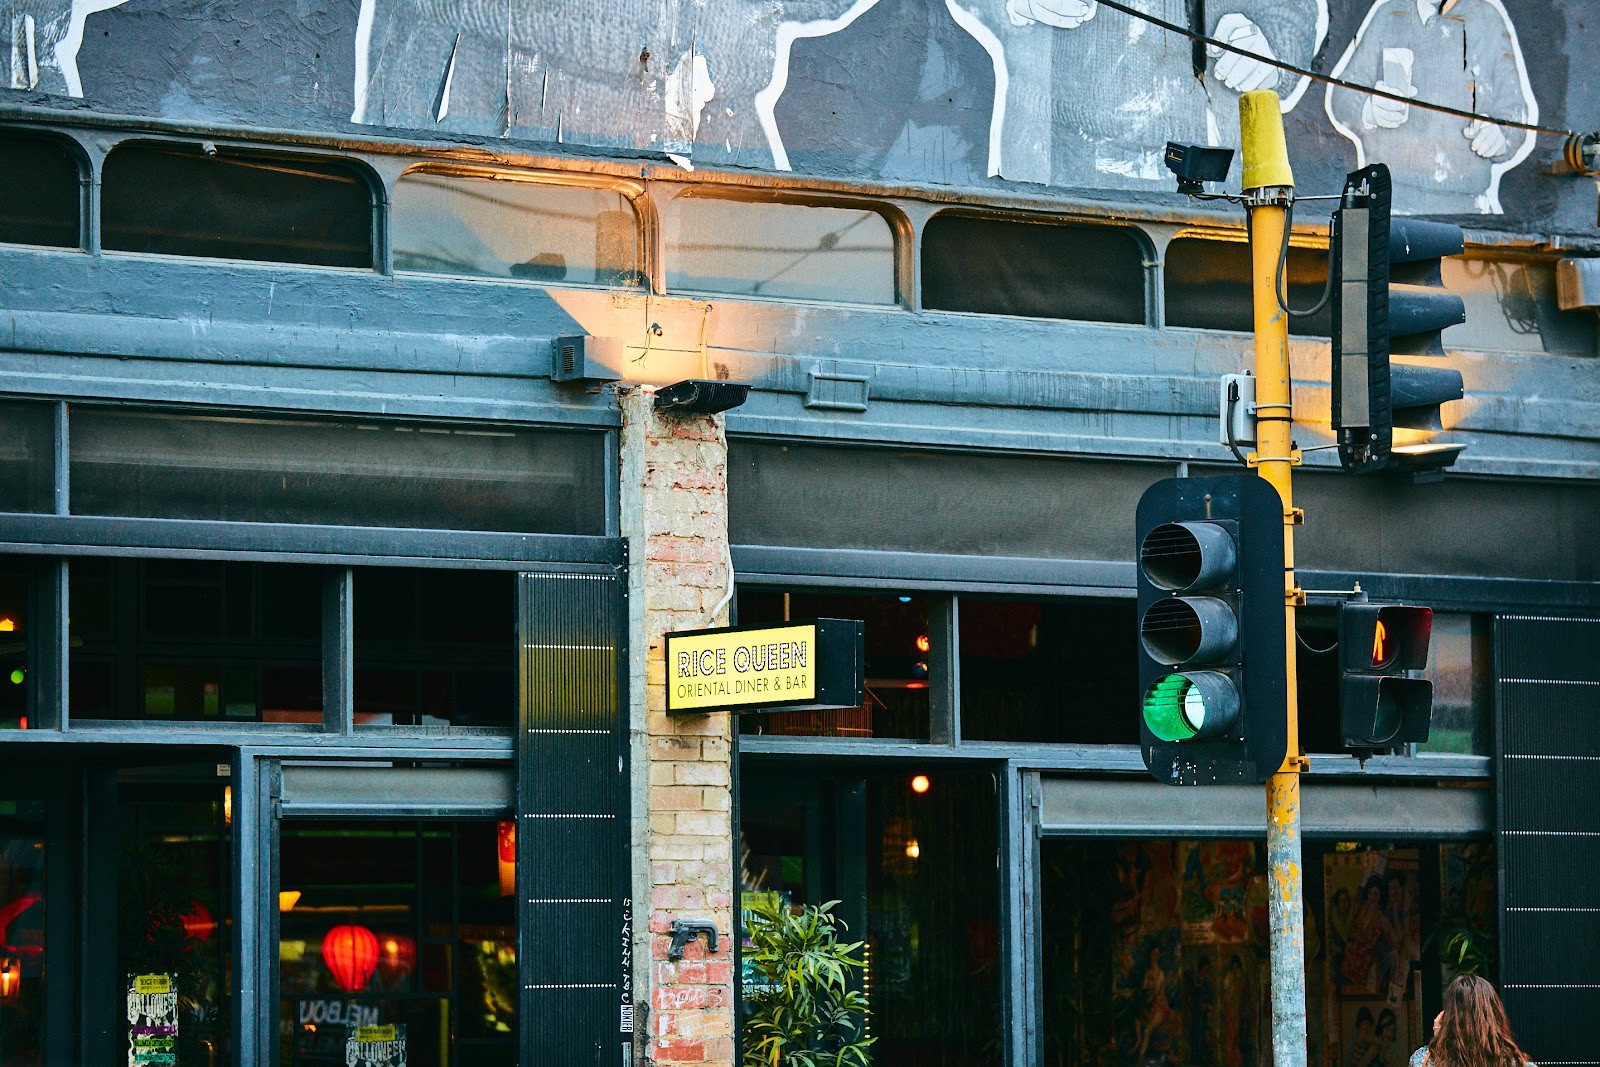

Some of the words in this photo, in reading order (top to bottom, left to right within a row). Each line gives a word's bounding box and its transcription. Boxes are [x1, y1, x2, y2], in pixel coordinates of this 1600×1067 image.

[678, 648, 726, 678] RICE
[733, 641, 807, 673] QUEEN
[677, 683, 731, 698] ORIENTAL
[735, 677, 769, 694] DINER
[773, 676, 781, 690] &
[786, 674, 807, 690] BAR
